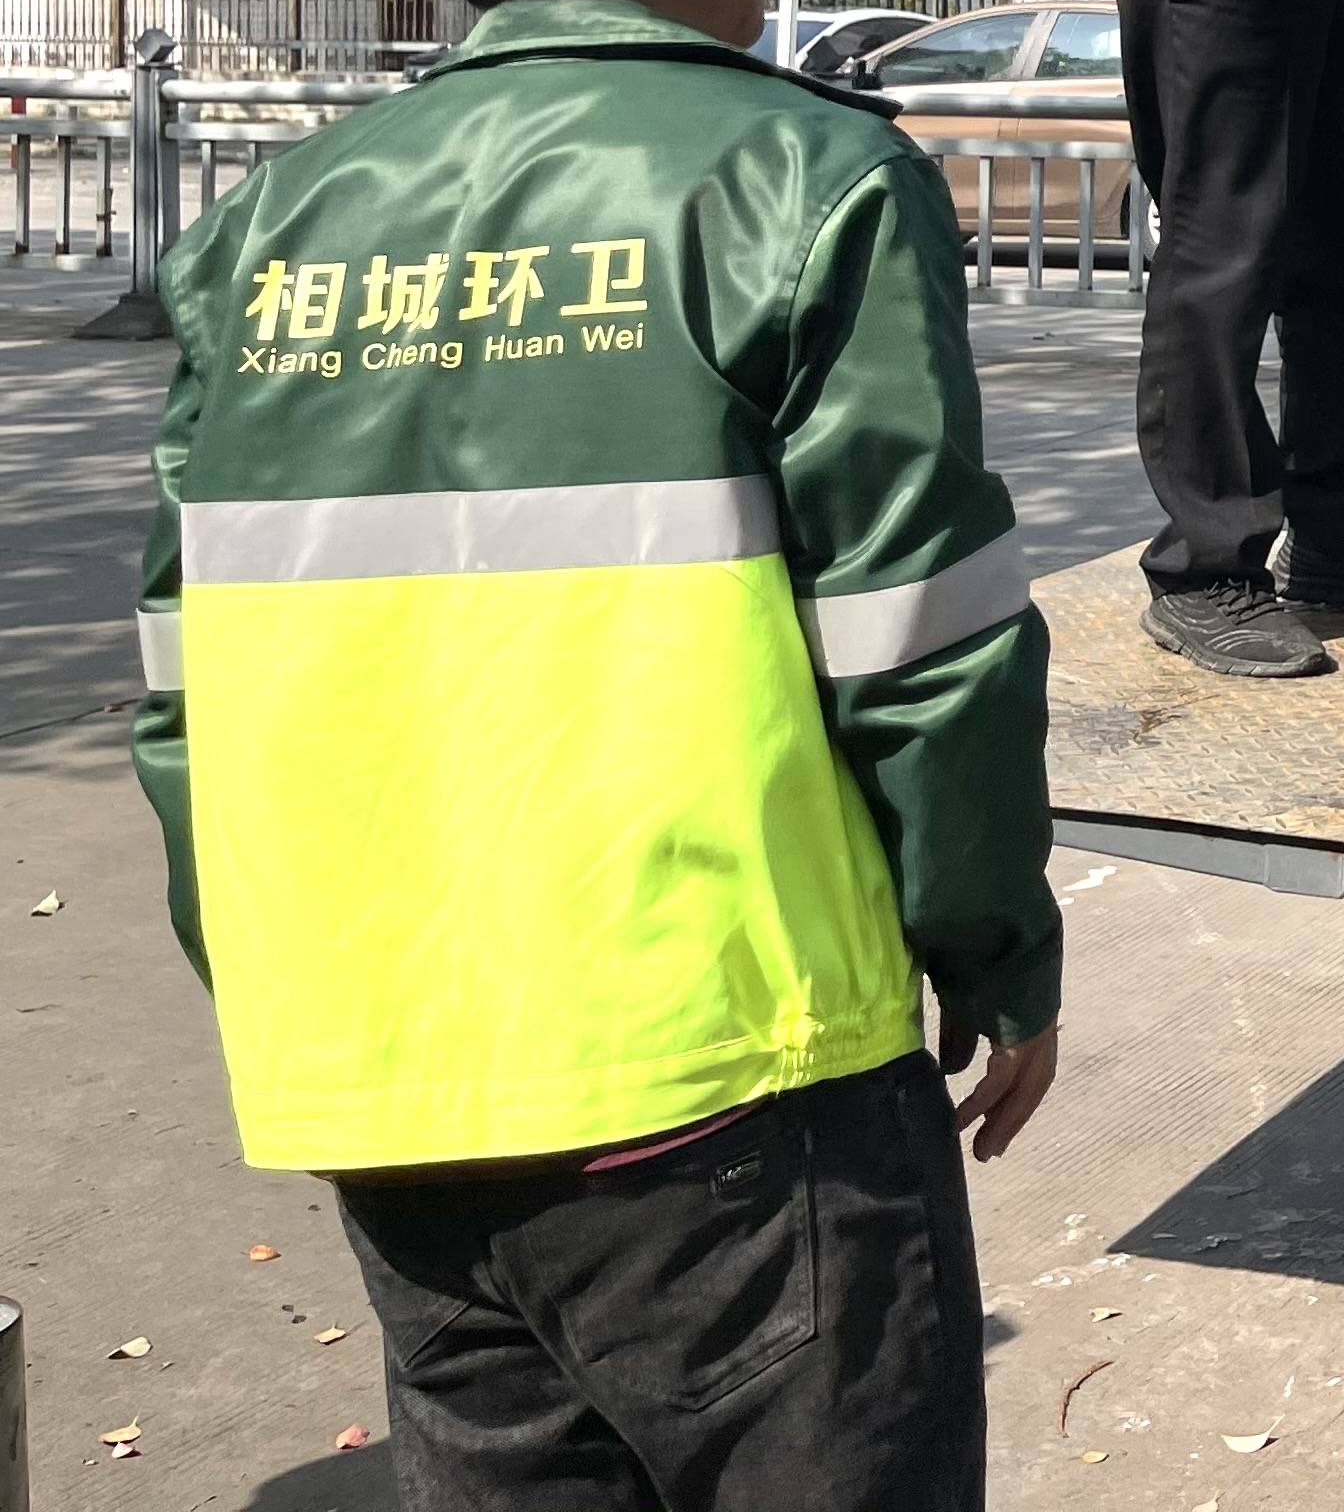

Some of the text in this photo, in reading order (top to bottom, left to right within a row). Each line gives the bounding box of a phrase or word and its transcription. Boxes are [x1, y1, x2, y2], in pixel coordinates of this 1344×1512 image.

[245, 238, 648, 341] 相城环卫
[237, 322, 645, 379] Xiang Cheng Huan Wei
